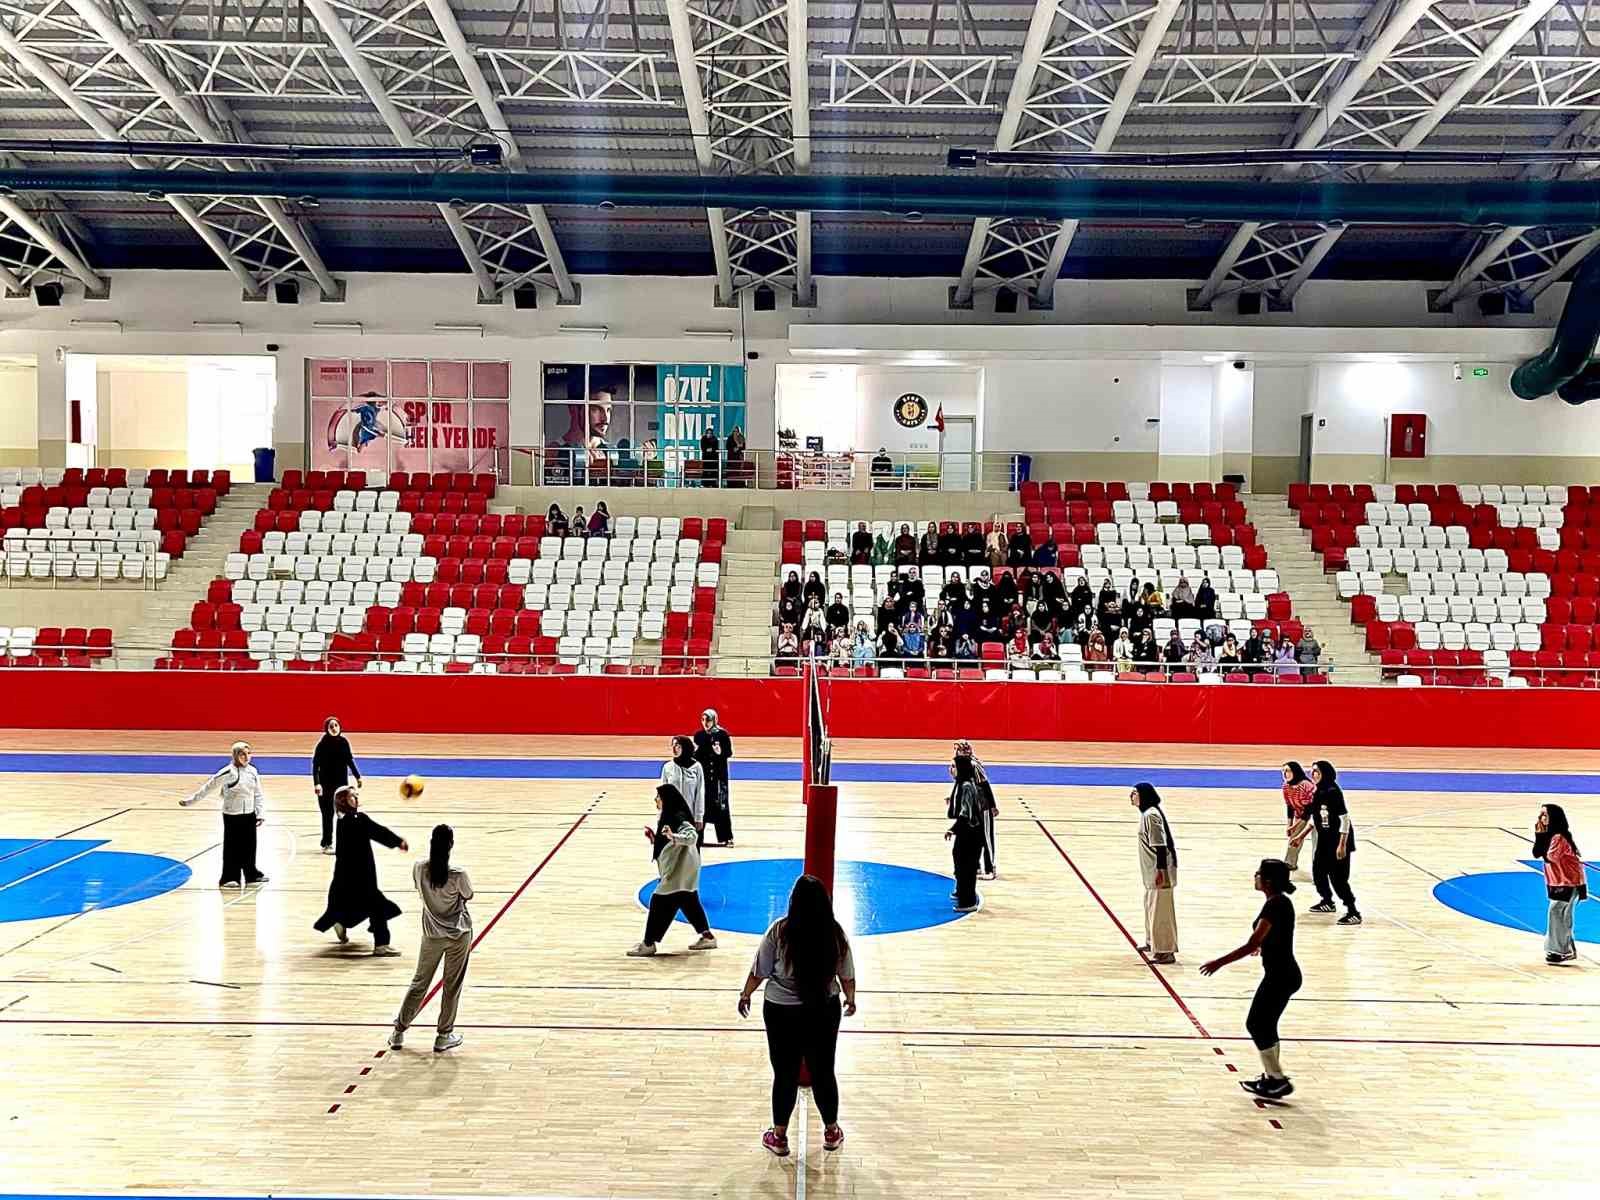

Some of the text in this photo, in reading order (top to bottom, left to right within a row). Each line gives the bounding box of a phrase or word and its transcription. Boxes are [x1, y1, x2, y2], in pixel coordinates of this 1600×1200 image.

[404, 401, 452, 423] SPOR
[405, 427, 496, 448] HER YERDE
